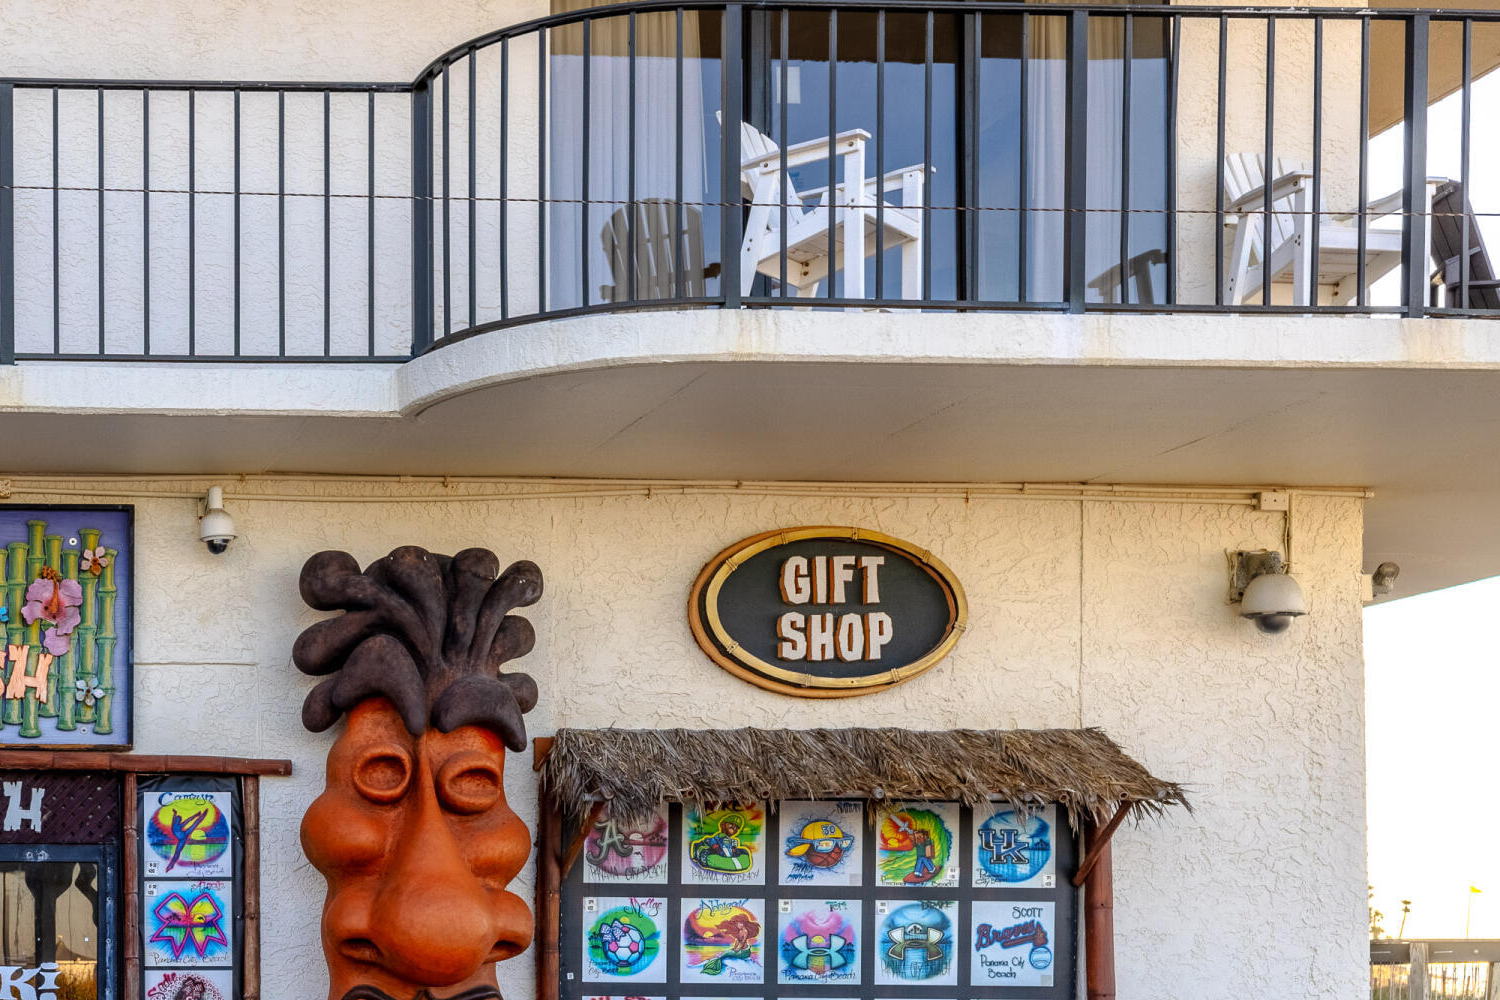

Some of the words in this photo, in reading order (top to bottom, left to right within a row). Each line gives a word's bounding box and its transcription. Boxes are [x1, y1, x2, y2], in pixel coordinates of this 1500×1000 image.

[779, 555, 885, 605] GIFT
[777, 611, 893, 662] SHOP
[821, 825, 836, 836] 30
[1012, 906, 1043, 918] SCOTT
[975, 919, 1036, 952] Braves
[980, 954, 1009, 968] Panama
[1012, 956, 1025, 968] City
[988, 967, 1017, 979] Beach
